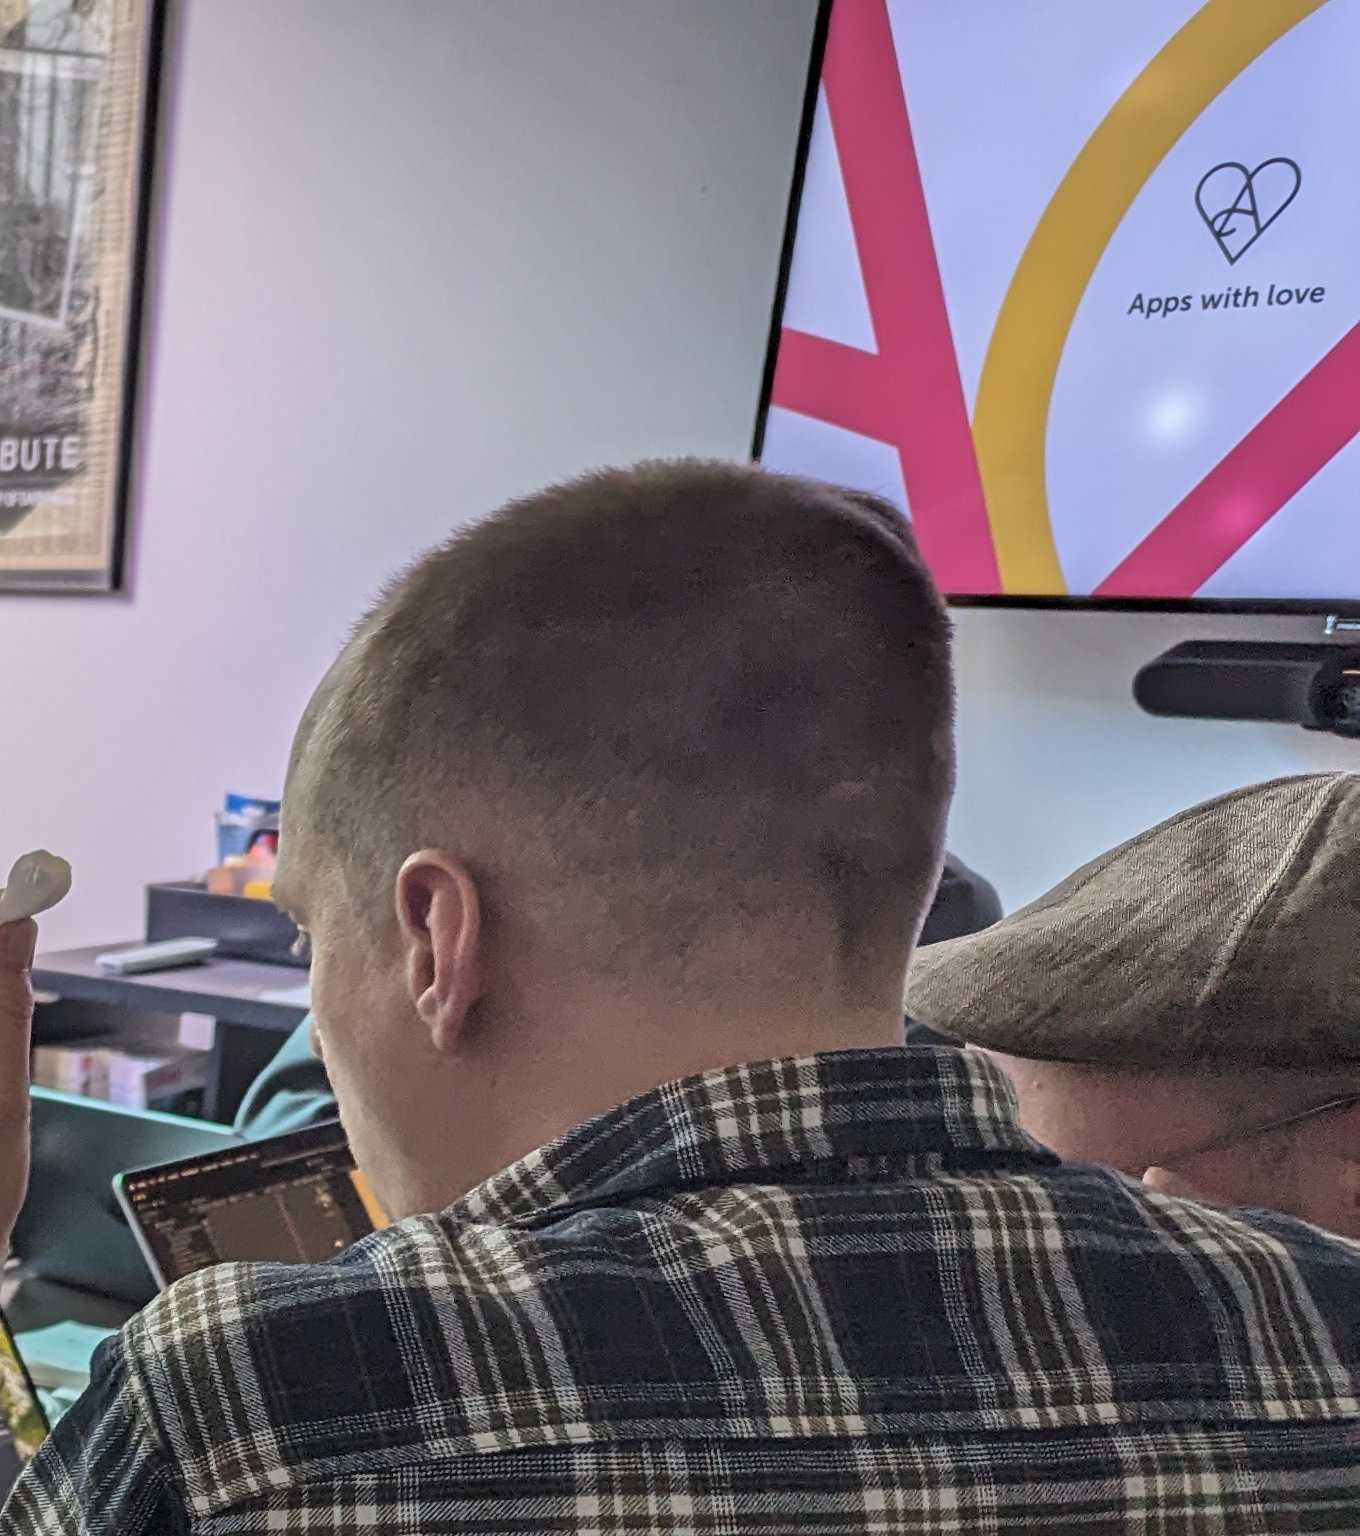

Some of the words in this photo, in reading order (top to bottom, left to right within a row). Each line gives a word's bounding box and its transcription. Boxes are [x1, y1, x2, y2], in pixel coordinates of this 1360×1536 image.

[1127, 292, 1193, 318] Apps
[1200, 286, 1260, 310] with
[1266, 283, 1326, 307] love
